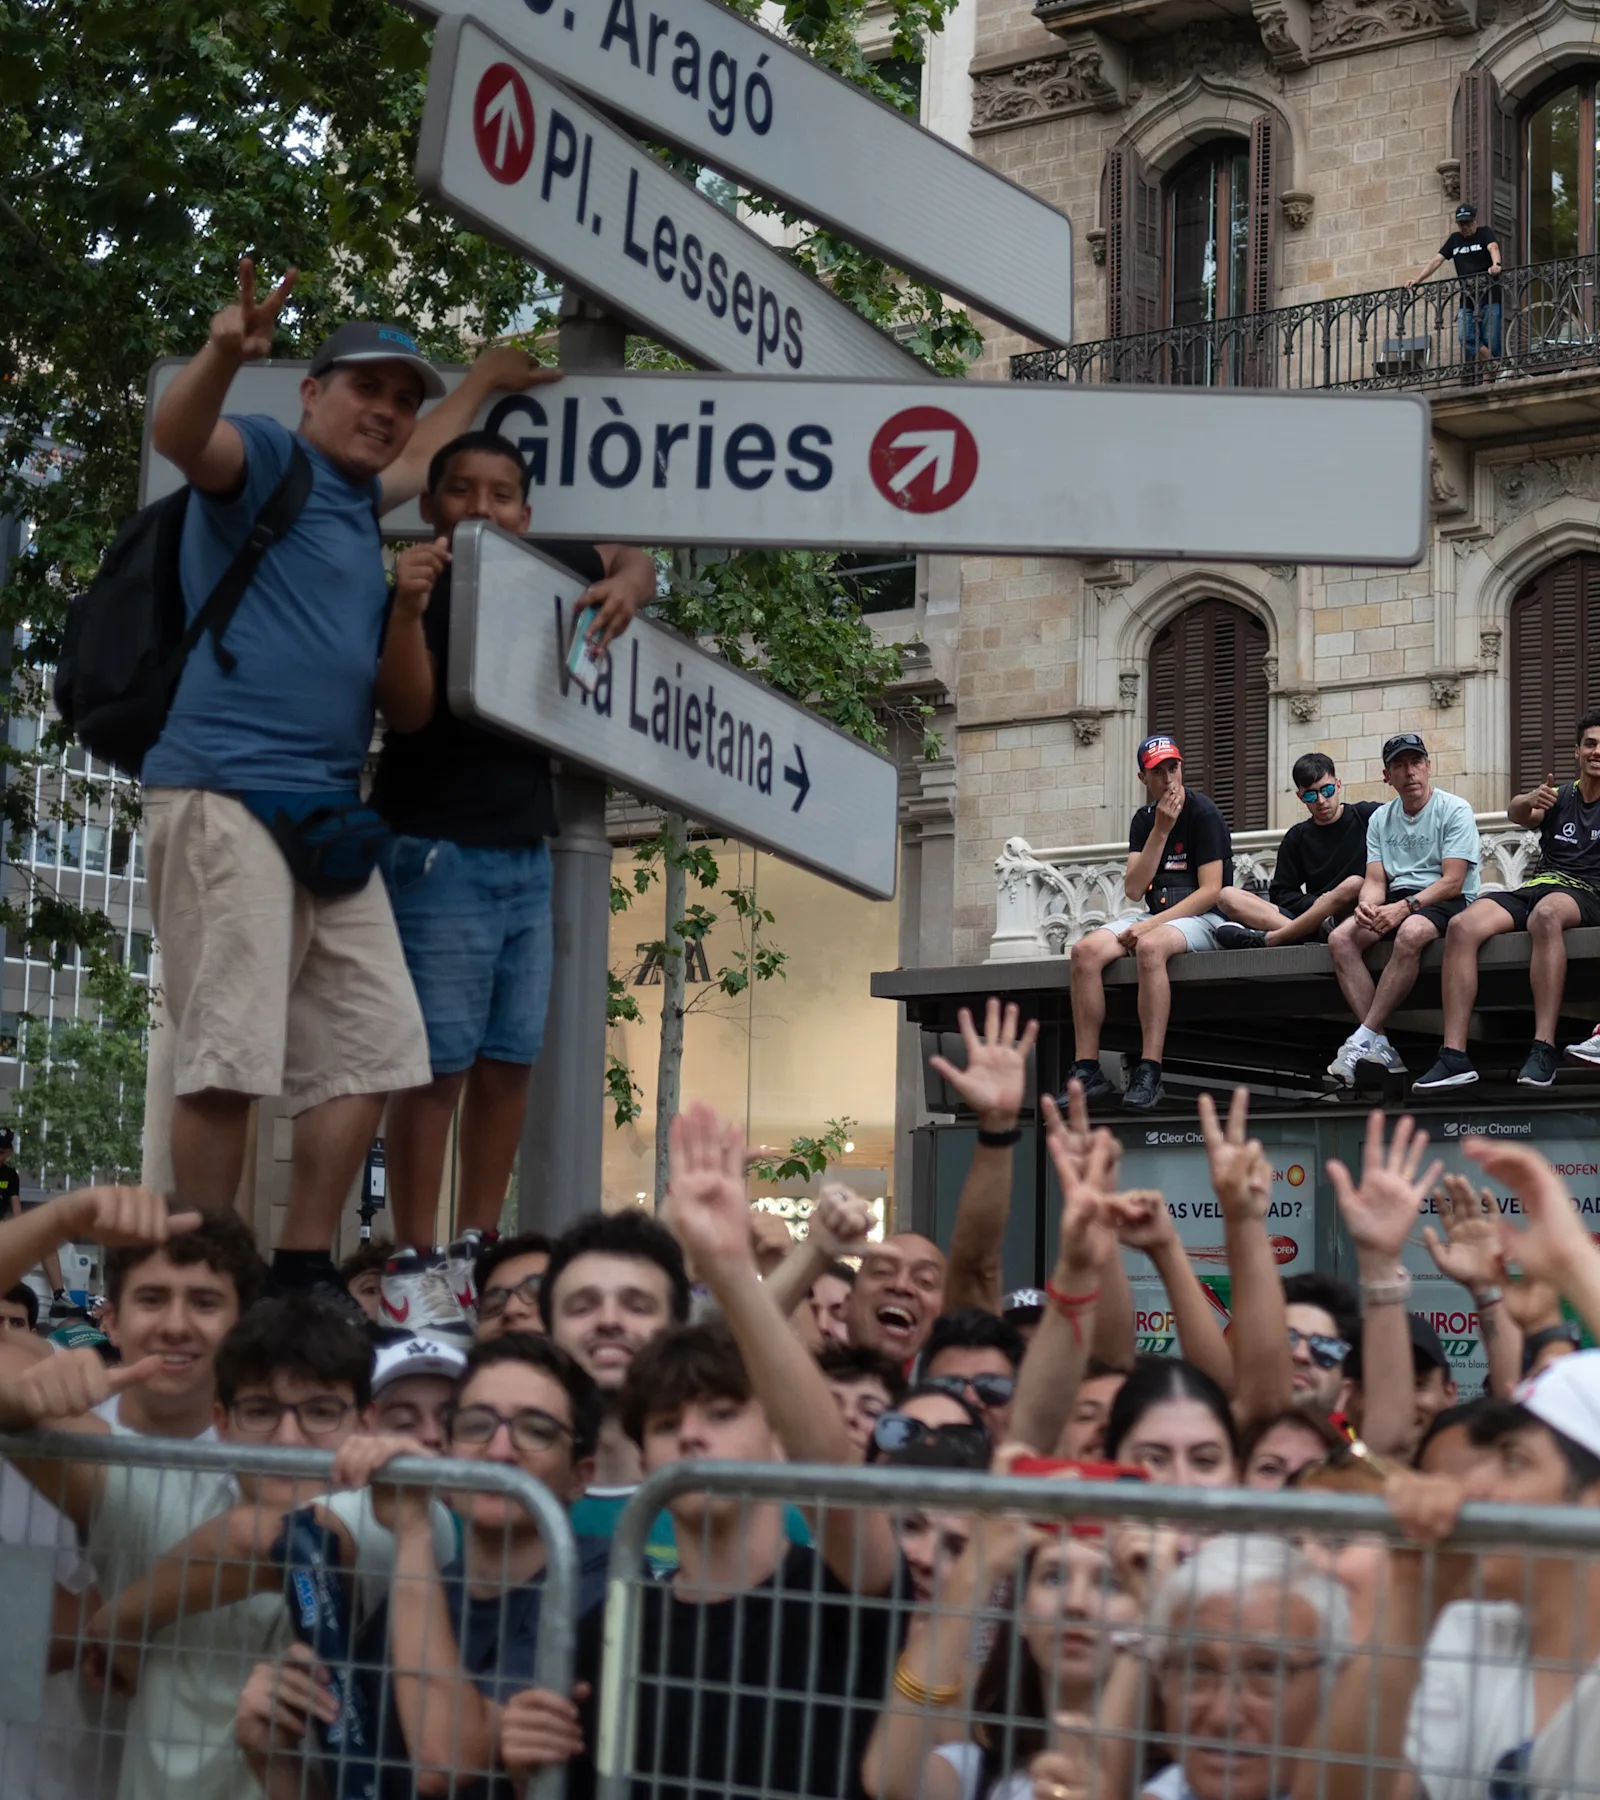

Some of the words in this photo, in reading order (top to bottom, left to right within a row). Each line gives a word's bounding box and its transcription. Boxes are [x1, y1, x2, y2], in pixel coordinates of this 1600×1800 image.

[599, 0, 773, 136] Aragó
[541, 108, 602, 236] Pl.
[623, 167, 804, 370] Lesseps
[483, 395, 834, 491] Glòries
[554, 595, 613, 718] Va
[629, 637, 774, 796] Laietana
[1459, 1123, 1487, 1136] Clear
[1488, 1122, 1532, 1135] Channel
[1159, 1132, 1185, 1144] Clear
[1549, 1163, 1598, 1176] UROFEN
[1191, 1202, 1302, 1219] VELAD?
[1273, 1246, 1295, 1255] ROFEN
